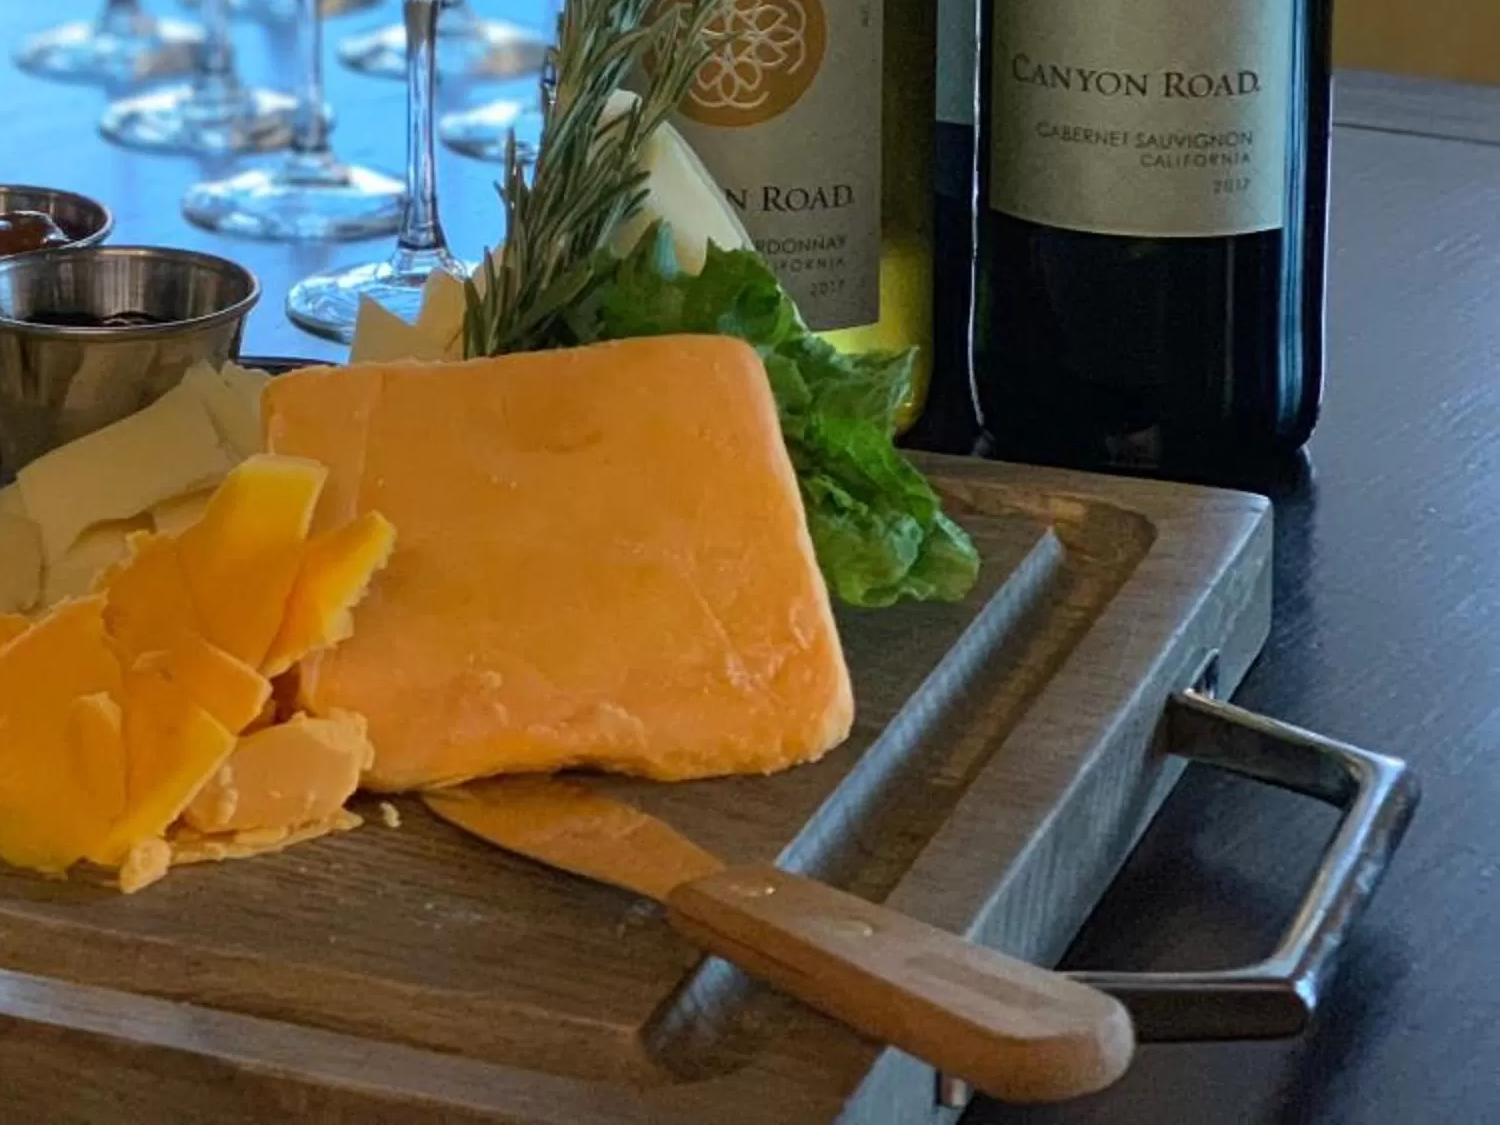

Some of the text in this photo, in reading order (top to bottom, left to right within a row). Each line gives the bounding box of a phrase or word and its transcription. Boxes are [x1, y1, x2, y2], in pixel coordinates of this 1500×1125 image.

[1011, 53, 1148, 97] CANYON
[1035, 122, 1253, 150] CABERNET SAUVIGNON
[1139, 152, 1251, 169] CALIFORNIA
[754, 234, 847, 255] RDONNAY
